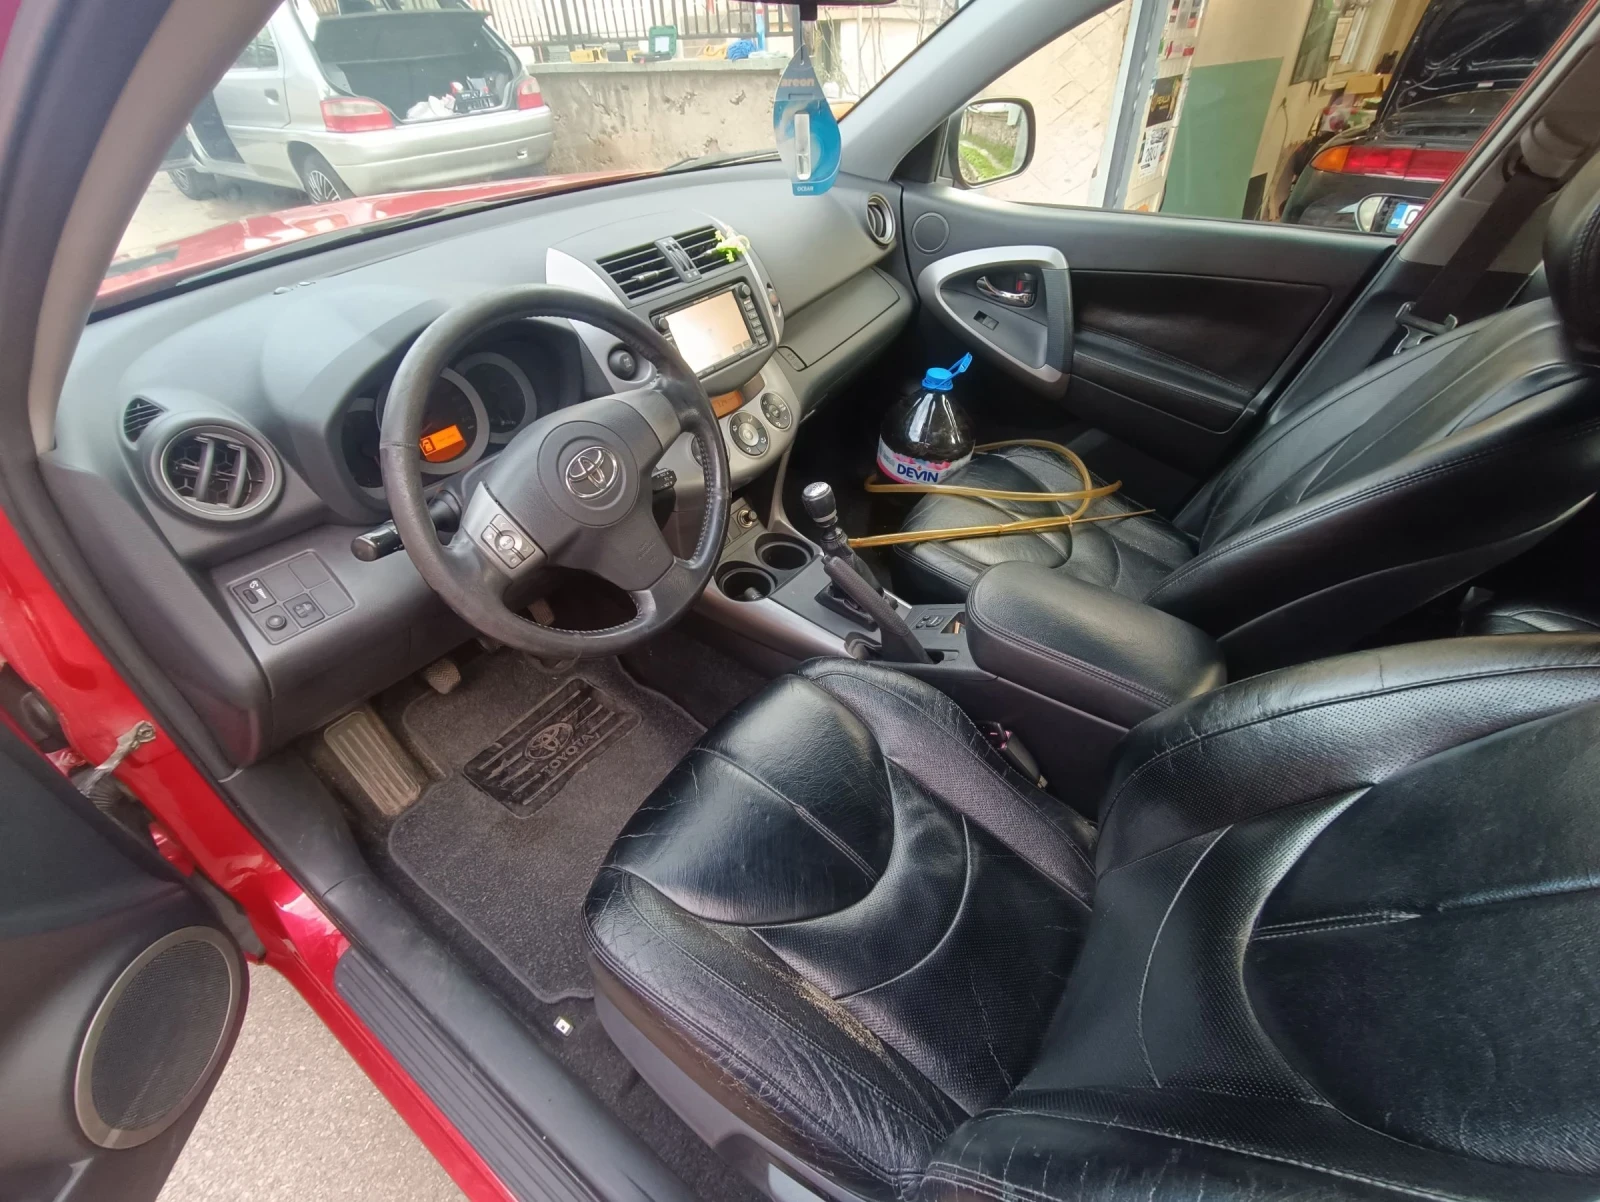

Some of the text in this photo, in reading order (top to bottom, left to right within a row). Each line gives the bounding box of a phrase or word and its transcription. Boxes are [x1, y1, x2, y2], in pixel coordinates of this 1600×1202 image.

[780, 78, 815, 87] areon
[896, 463, 940, 483] DEVIN
[540, 734, 595, 775] TOYOTA
